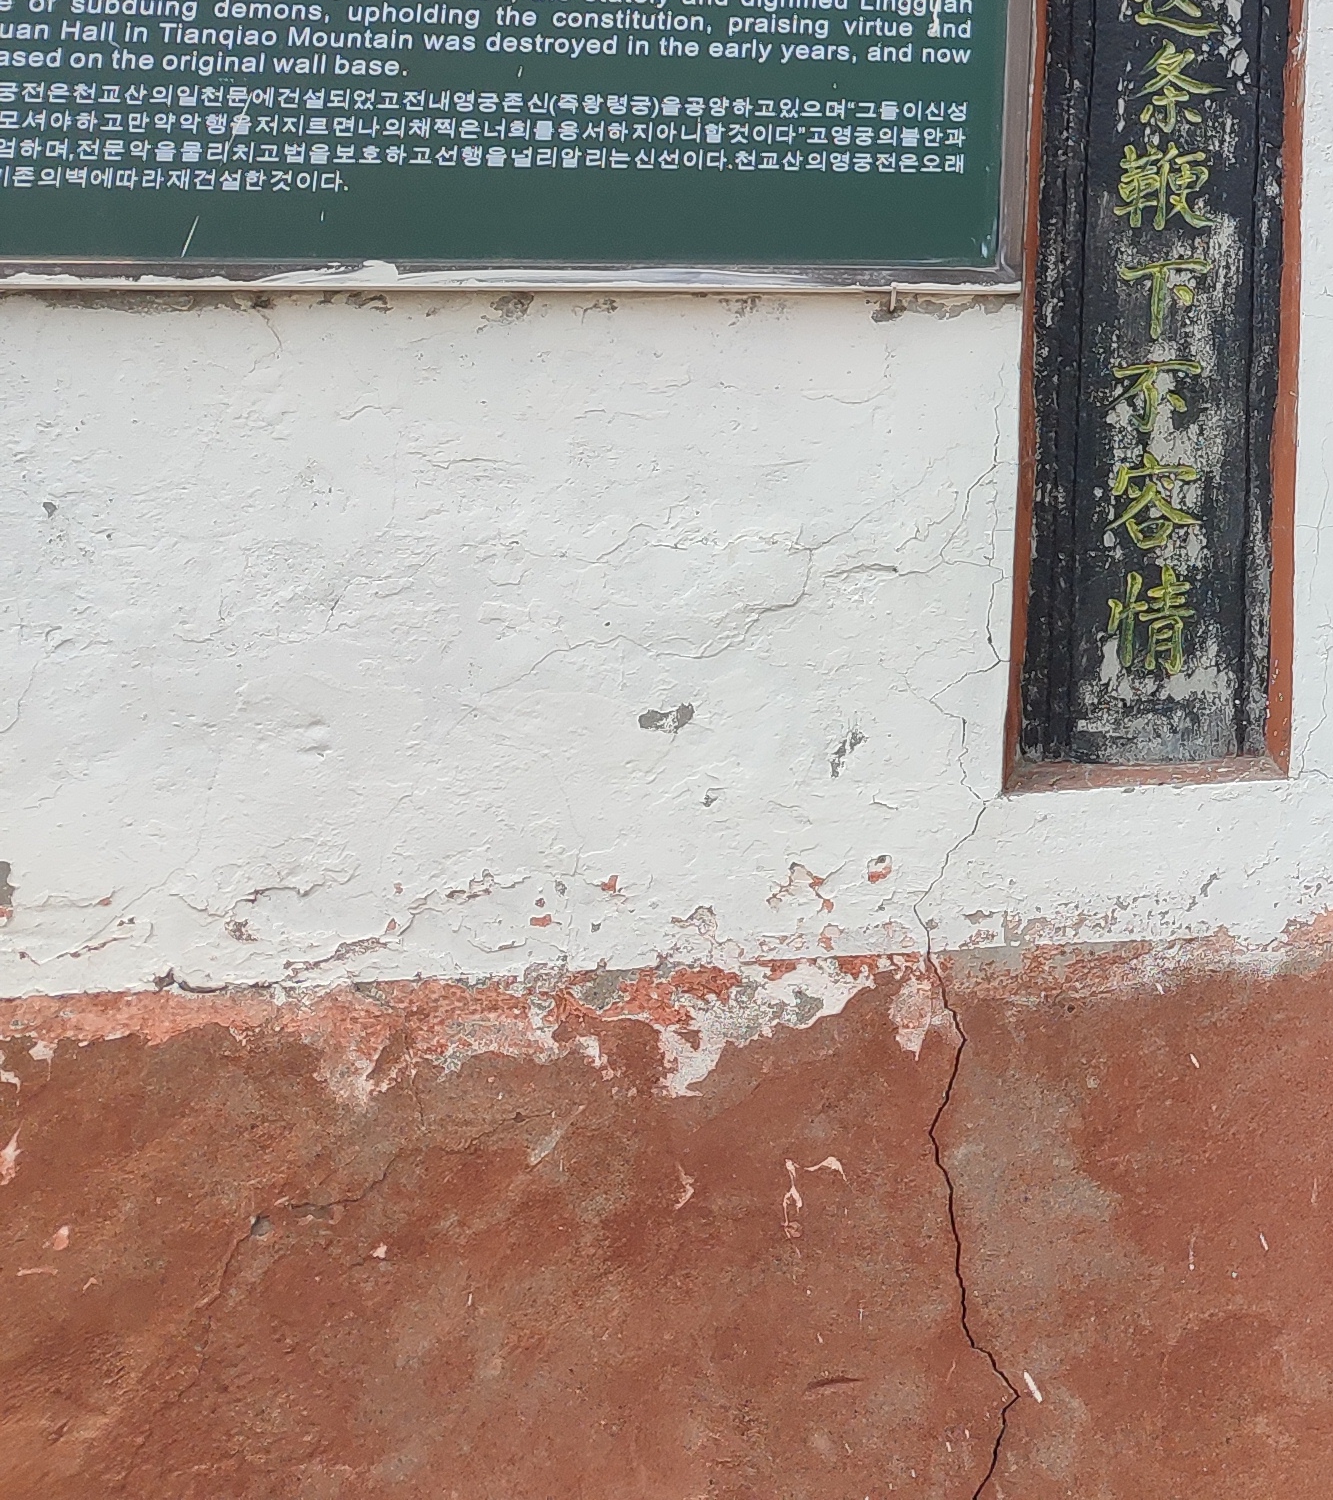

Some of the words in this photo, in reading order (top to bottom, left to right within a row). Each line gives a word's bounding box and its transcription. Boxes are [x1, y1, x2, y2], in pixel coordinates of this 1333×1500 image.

[349, 2, 479, 29] upholding
[496, 6, 536, 26] the
[553, 9, 711, 34] constitution,
[729, 14, 828, 38] praising
[843, 17, 912, 36] virtue
[927, 18, 971, 38] and
[61, 20, 114, 42] Hall
[125, 22, 147, 43] in
[160, 23, 277, 50] Tianqiao
[288, 27, 412, 49] Mountain
[424, 34, 475, 51] was
[486, 32, 617, 58] destroyed
[628, 36, 648, 55] in
[660, 37, 699, 56] the
[709, 39, 772, 63] early
[781, 44, 856, 63] years,
[868, 42, 912, 62] and
[922, 48, 971, 63] now
[70, 53, 102, 68] on
[112, 49, 154, 70] the
[163, 51, 265, 77] original
[273, 53, 326, 74] wall
[335, 55, 407, 76] base.
